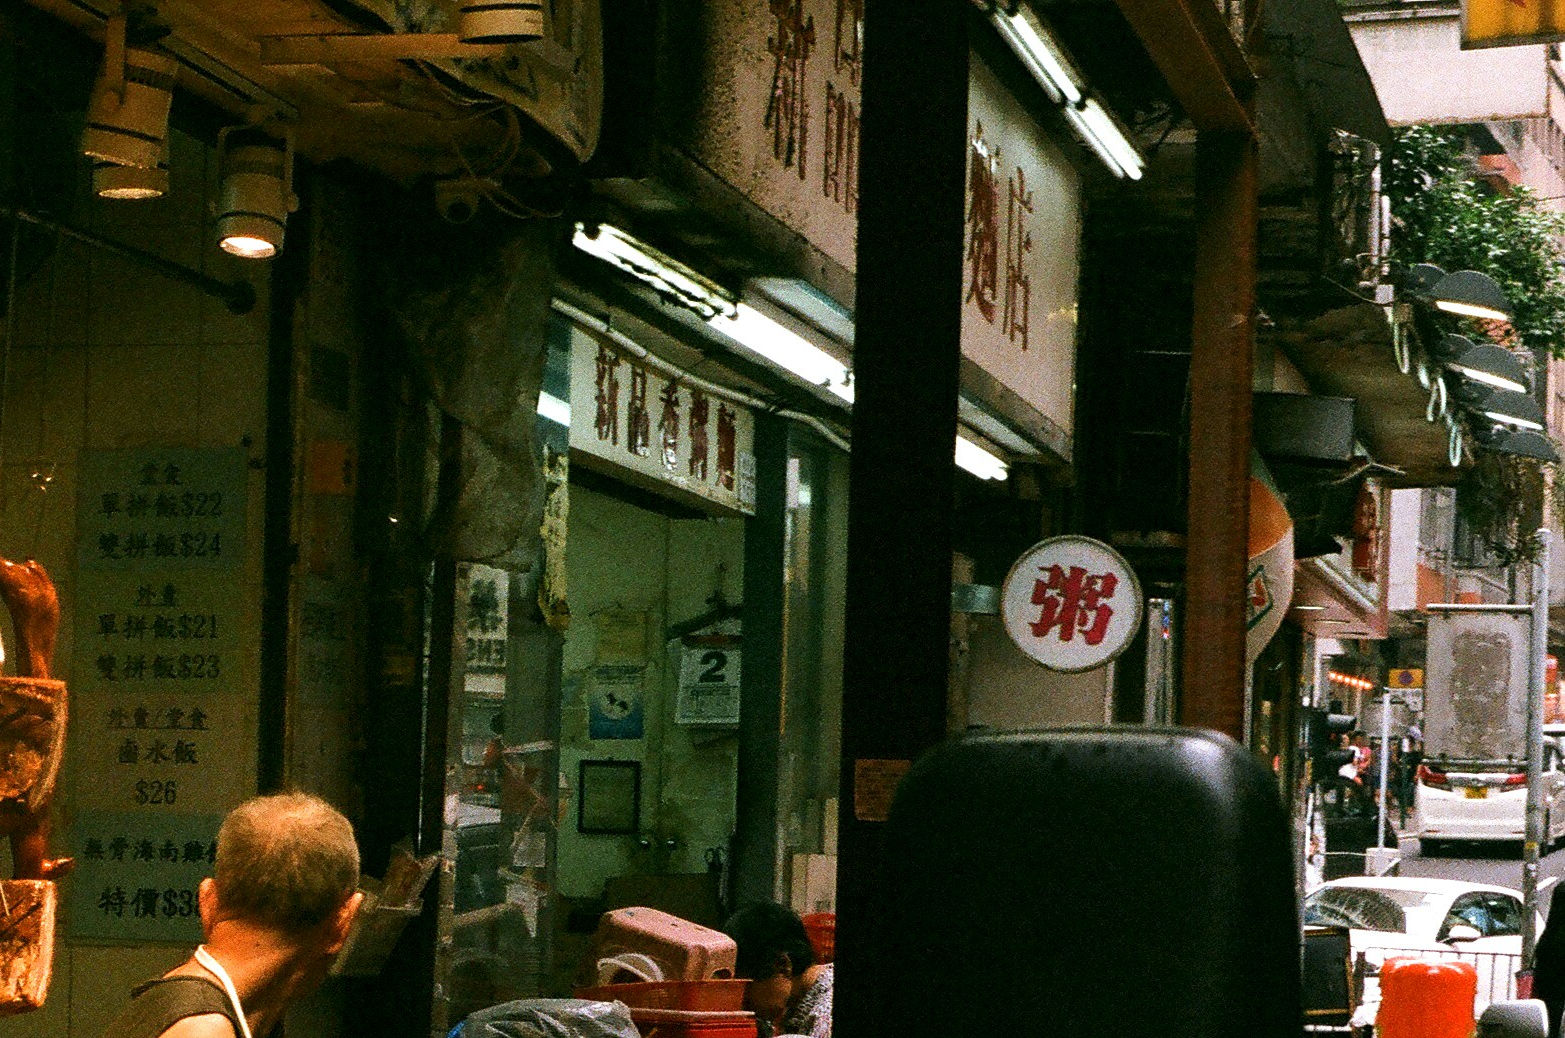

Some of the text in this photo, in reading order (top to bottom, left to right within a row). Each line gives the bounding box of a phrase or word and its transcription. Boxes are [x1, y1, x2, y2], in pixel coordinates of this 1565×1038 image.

[139, 461, 183, 484] 堂食
[97, 492, 223, 518] 單拼飯$22
[97, 532, 223, 560] 雙拼飯$24
[1028, 564, 1119, 647] 粥
[95, 612, 219, 641] 單拼飯$21
[95, 653, 221, 682] 雙拼飯$23
[699, 650, 728, 683] 2
[134, 778, 178, 805] $26
